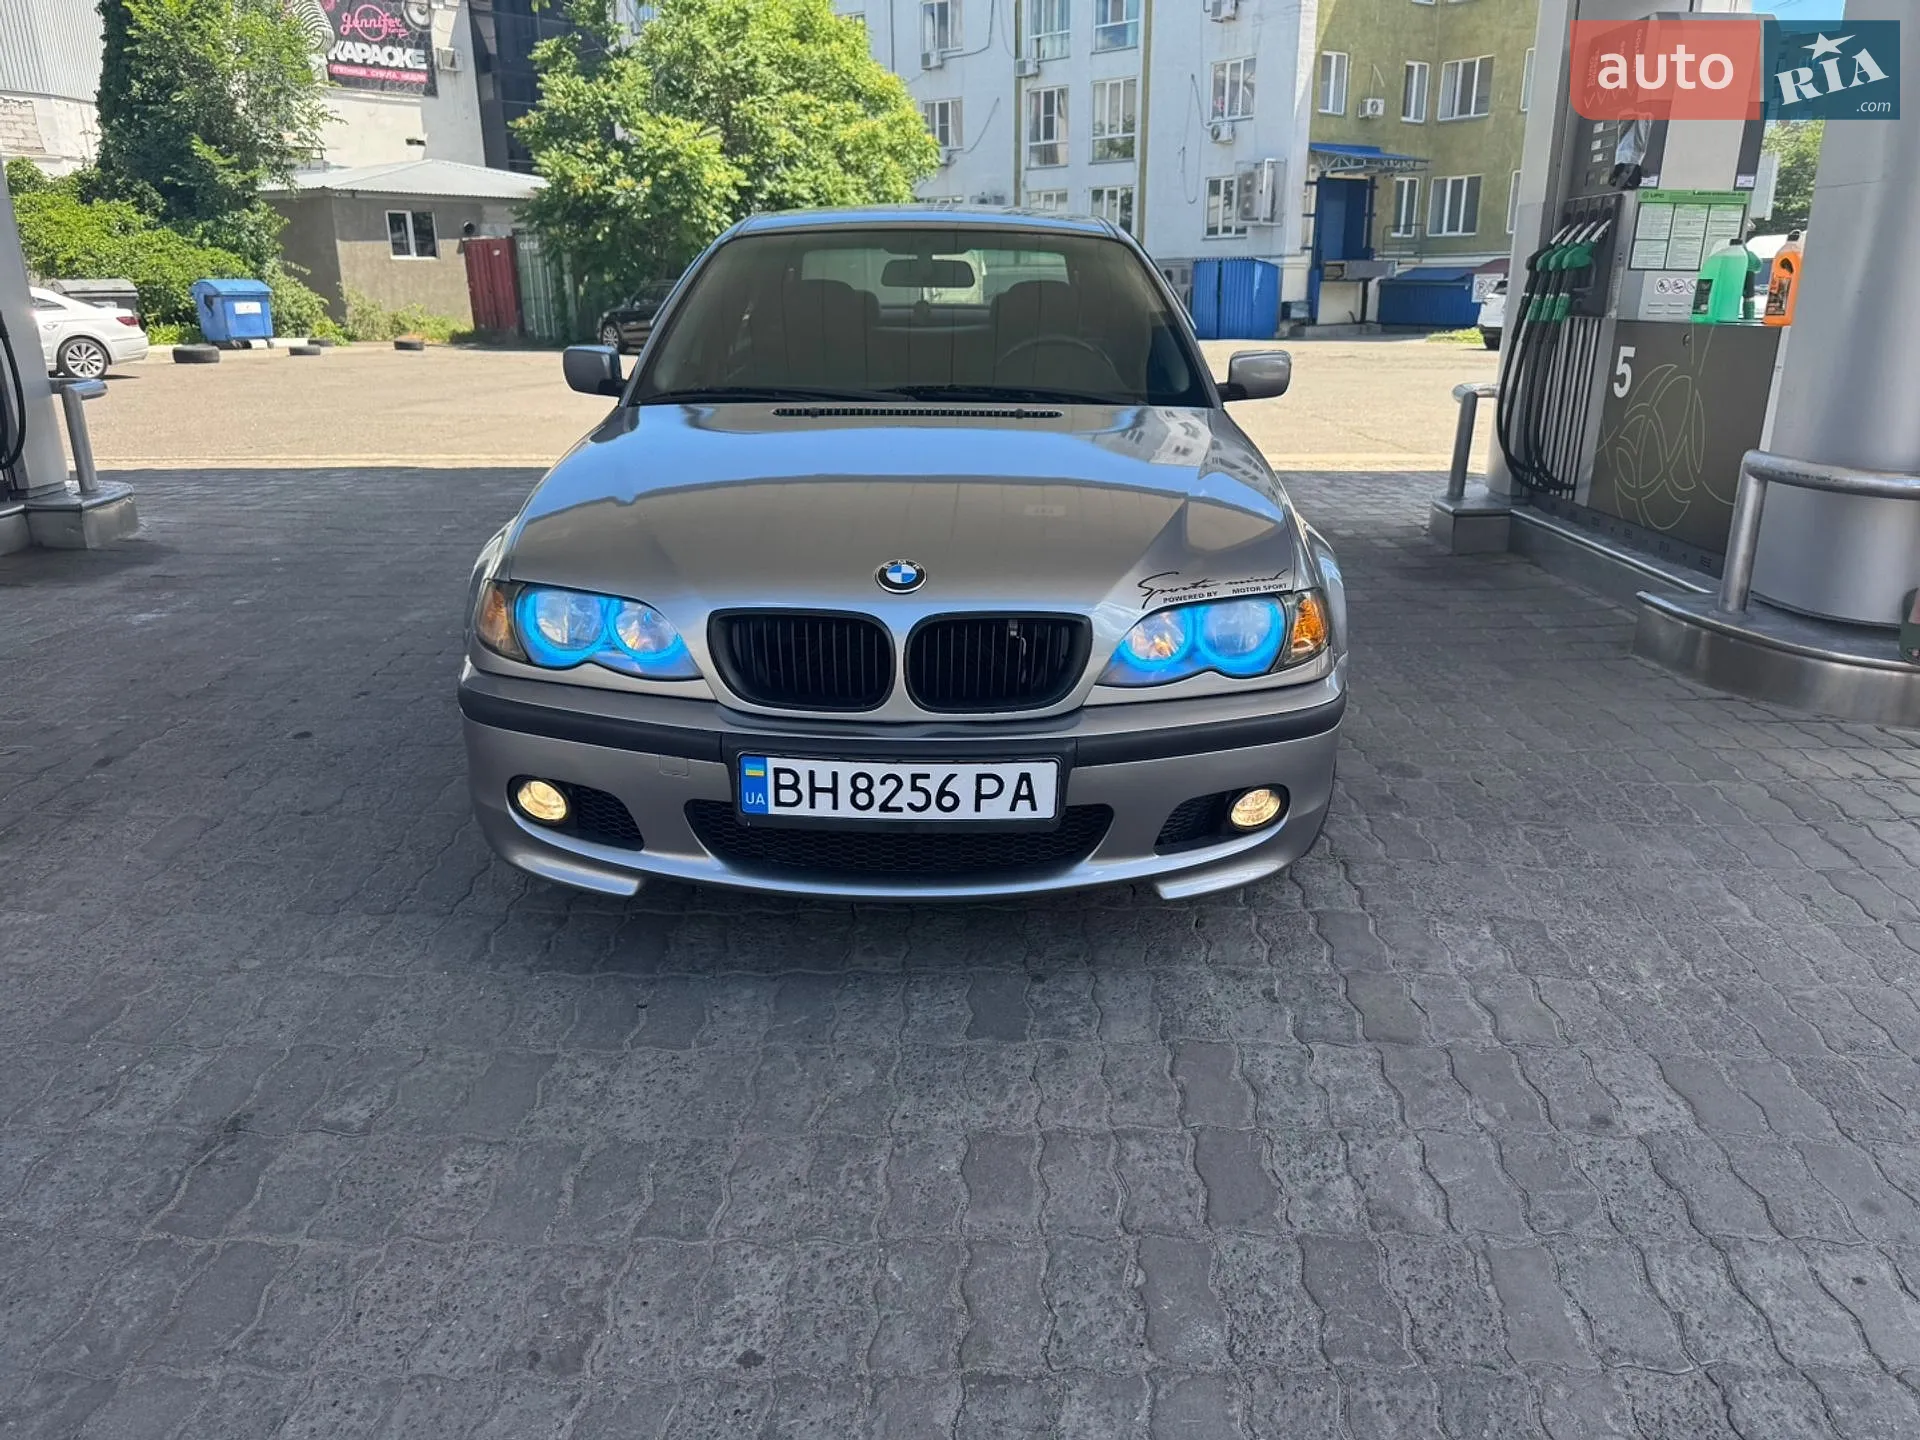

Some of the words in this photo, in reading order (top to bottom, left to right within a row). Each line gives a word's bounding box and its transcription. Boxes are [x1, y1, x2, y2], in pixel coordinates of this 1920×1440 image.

[340, 12, 403, 36] Jennifer
[328, 40, 428, 70] КАРАОКЕ
[1613, 346, 1636, 399] 5
[1162, 592, 1205, 604] POWERED
[1206, 590, 1218, 598] BY
[1231, 586, 1261, 595] MOTOR
[1262, 582, 1288, 592] SPORT
[745, 791, 766, 806] UA
[773, 767, 838, 811] BH
[850, 773, 960, 813] 8256
[974, 772, 1038, 812] PA
